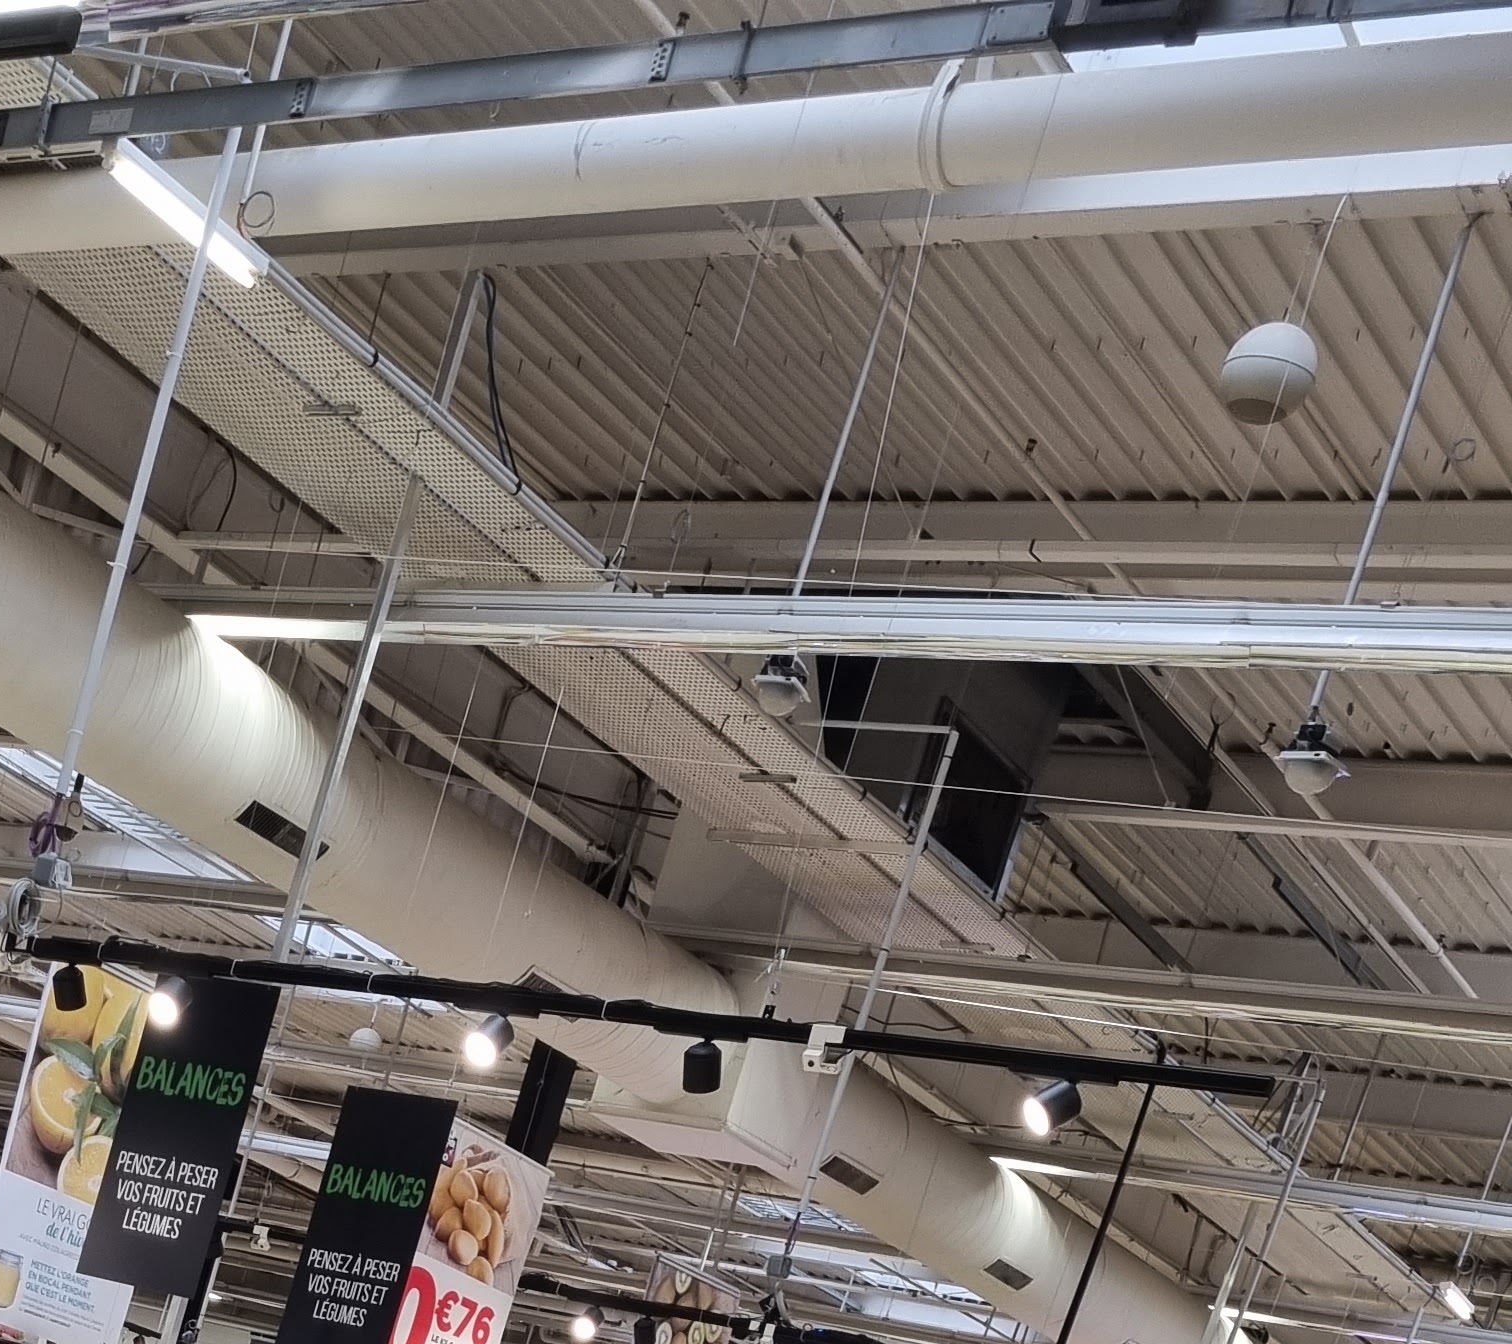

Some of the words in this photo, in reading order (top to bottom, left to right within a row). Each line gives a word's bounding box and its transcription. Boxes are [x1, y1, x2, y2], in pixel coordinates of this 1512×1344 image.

[136, 1056, 246, 1106] BALANCES
[116, 1151, 166, 1179] PENSEZ
[165, 1156, 175, 1181] À
[176, 1163, 218, 1189] PESER
[326, 1164, 426, 1208] BALANCES
[37, 1197, 50, 1216] LE
[52, 1202, 76, 1225] VRAI
[116, 1179, 143, 1202] VOS
[142, 1184, 187, 1211] FRUITS
[186, 1193, 205, 1215] ET
[122, 1207, 182, 1239] LÉGUMES
[31, 1260, 56, 1275] METTEZ
[57, 1268, 89, 1287] L'ORANGE
[307, 1248, 353, 1273] PENSEZ
[352, 1254, 362, 1275] À
[362, 1259, 400, 1282] PESER
[26, 1281, 39, 1293] QUE
[40, 1286, 58, 1299] C'EST
[38, 1274, 60, 1290] BOCAL
[61, 1282, 91, 1299] PENDANT
[308, 1273, 331, 1294] VOS
[331, 1278, 371, 1303] FRUITS
[371, 1285, 389, 1305] ET
[313, 1298, 367, 1327] LÉGUMES
